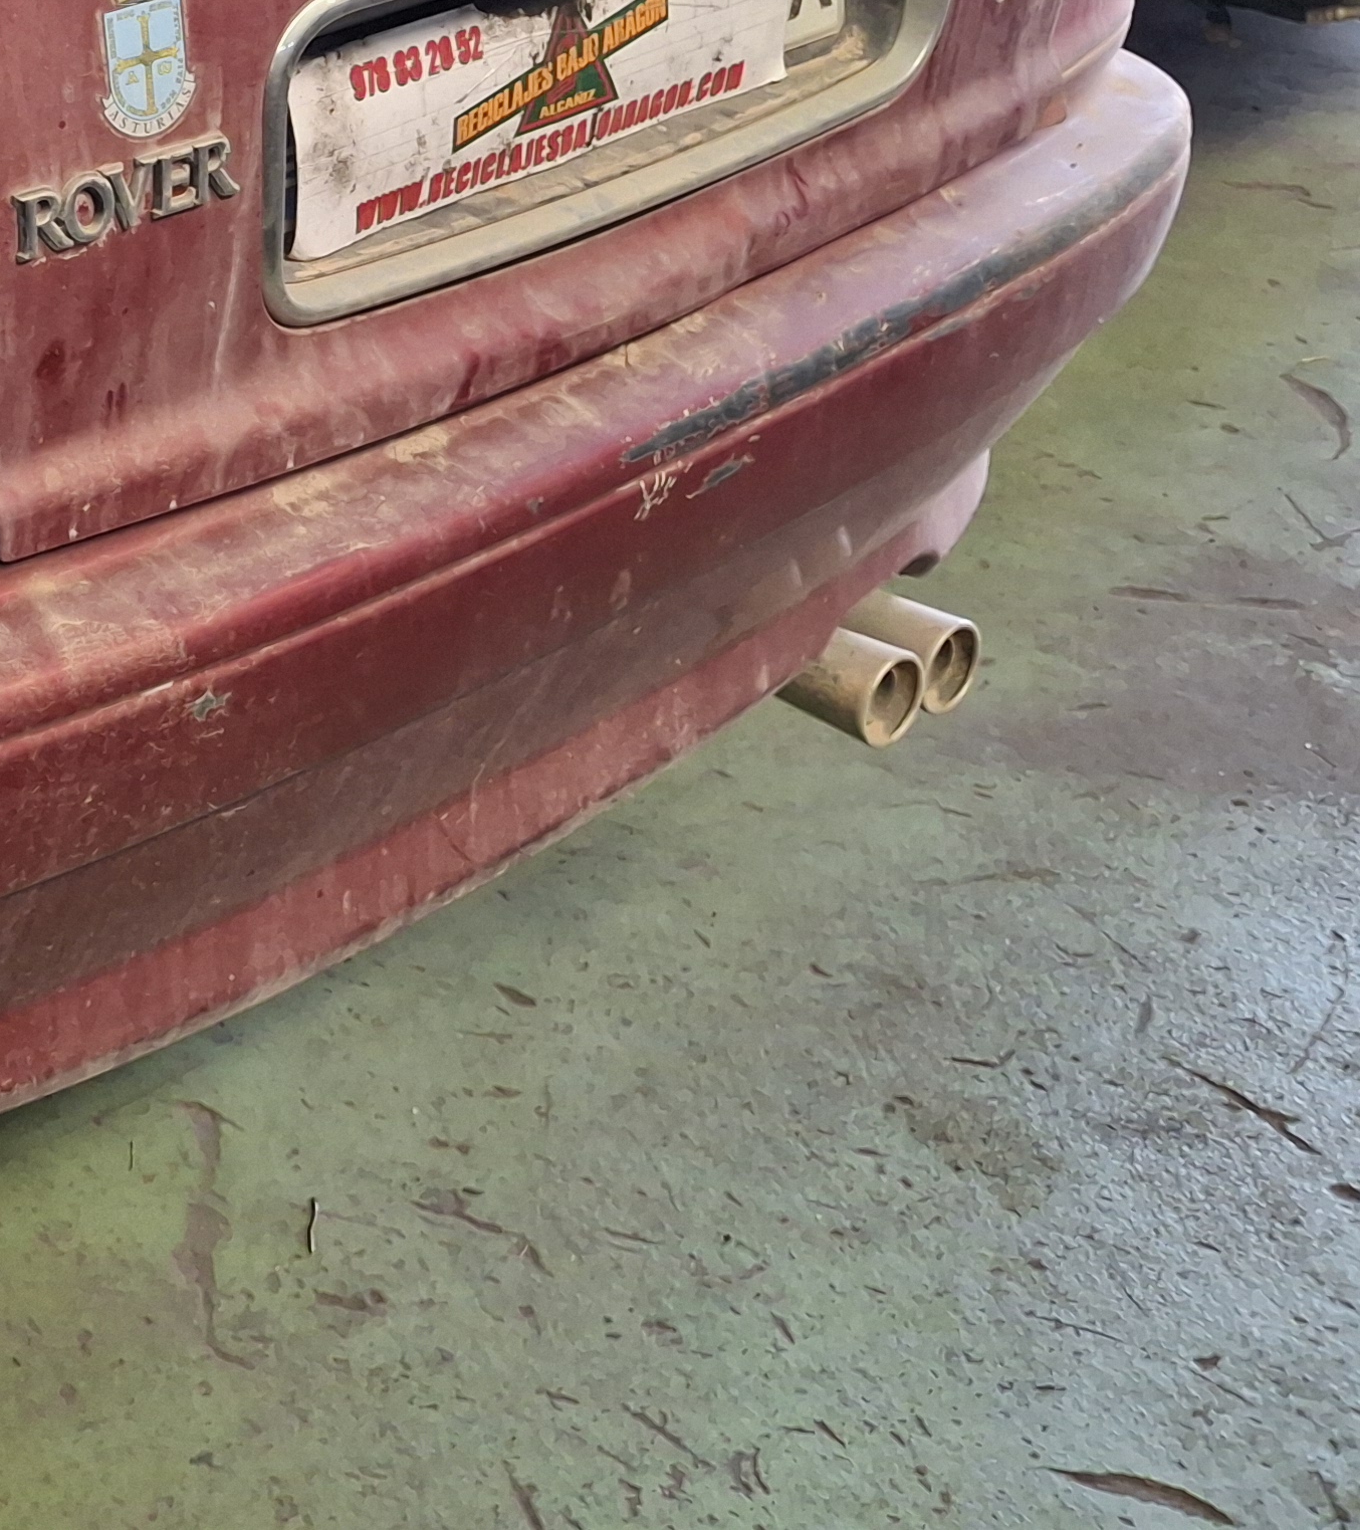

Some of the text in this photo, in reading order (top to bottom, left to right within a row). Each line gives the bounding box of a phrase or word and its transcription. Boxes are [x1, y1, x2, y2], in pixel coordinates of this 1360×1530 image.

[349, 56, 391, 101] 978
[393, 46, 422, 86] 83
[455, 26, 484, 65] 52
[456, 62, 555, 146] RECICLAJES
[556, 32, 600, 78] BAJO
[109, 87, 192, 135] ASTURIAS
[10, 132, 241, 266] ROVER
